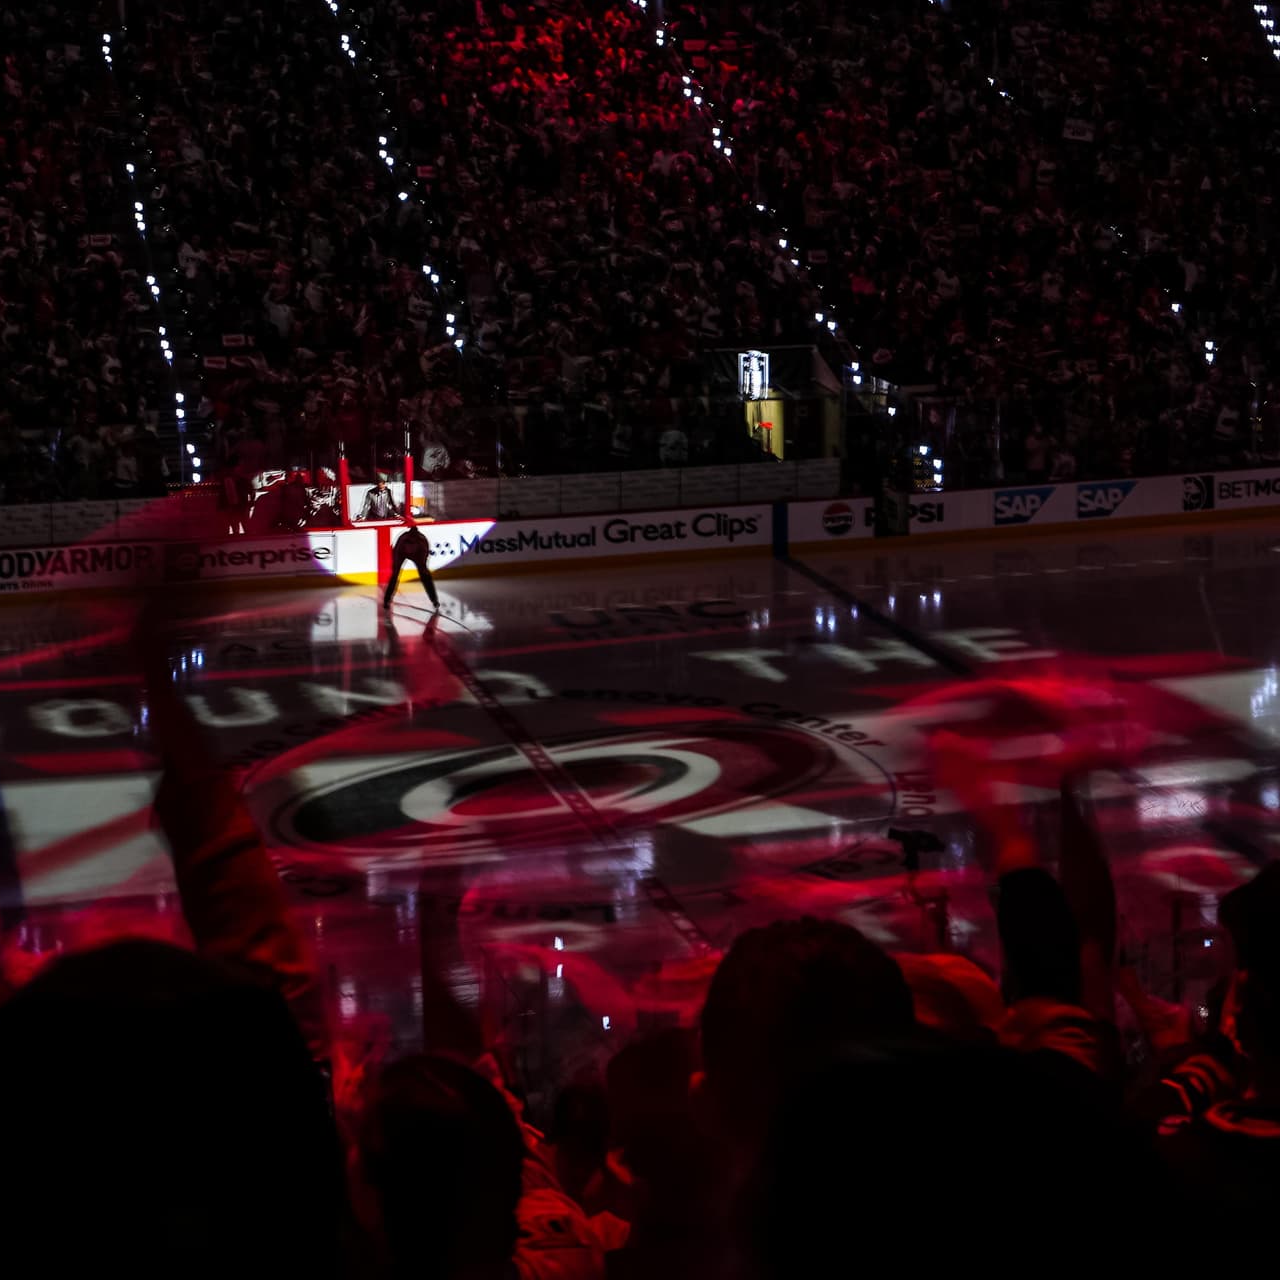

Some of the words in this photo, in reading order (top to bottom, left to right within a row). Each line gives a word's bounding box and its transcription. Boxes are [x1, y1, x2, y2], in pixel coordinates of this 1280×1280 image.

[996, 494, 1042, 520] SAP
[1079, 486, 1121, 514] SAP
[604, 516, 685, 542] Great
[693, 510, 758, 542] Clips
[460, 526, 596, 556] MassMutual
[178, 543, 333, 572] enterprise
[552, 599, 747, 628] UNC
[692, 627, 1058, 684] THE
[741, 701, 886, 749] Center
